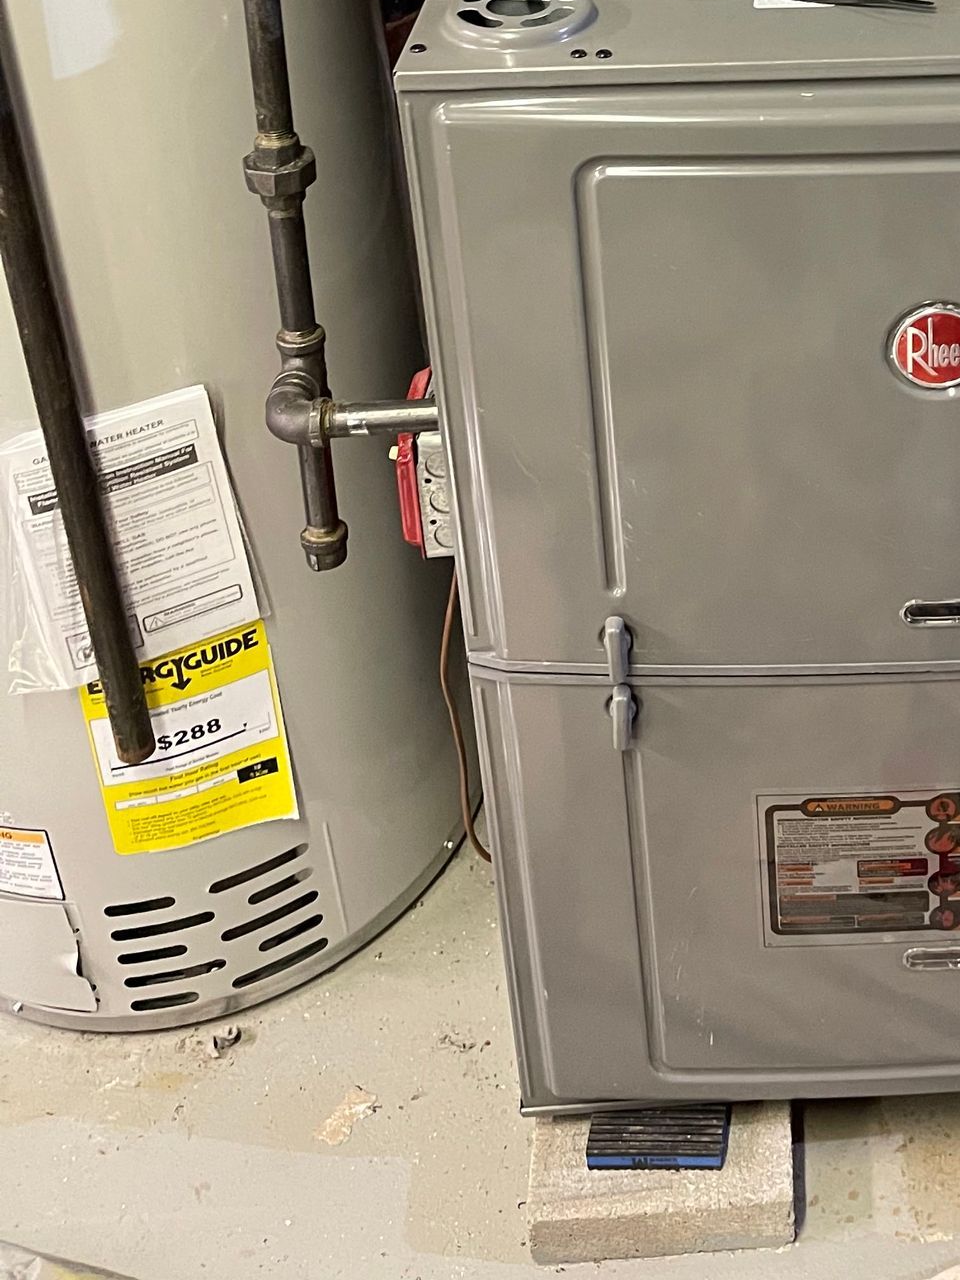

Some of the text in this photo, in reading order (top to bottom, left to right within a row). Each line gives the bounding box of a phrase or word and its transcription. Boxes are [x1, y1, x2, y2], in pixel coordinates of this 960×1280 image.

[125, 419, 164, 438] HEATER
[87, 628, 259, 695] ERGYGUIDE
[188, 696, 209, 708] Energy
[157, 718, 222, 751] $288
[826, 803, 880, 811] WARNING
